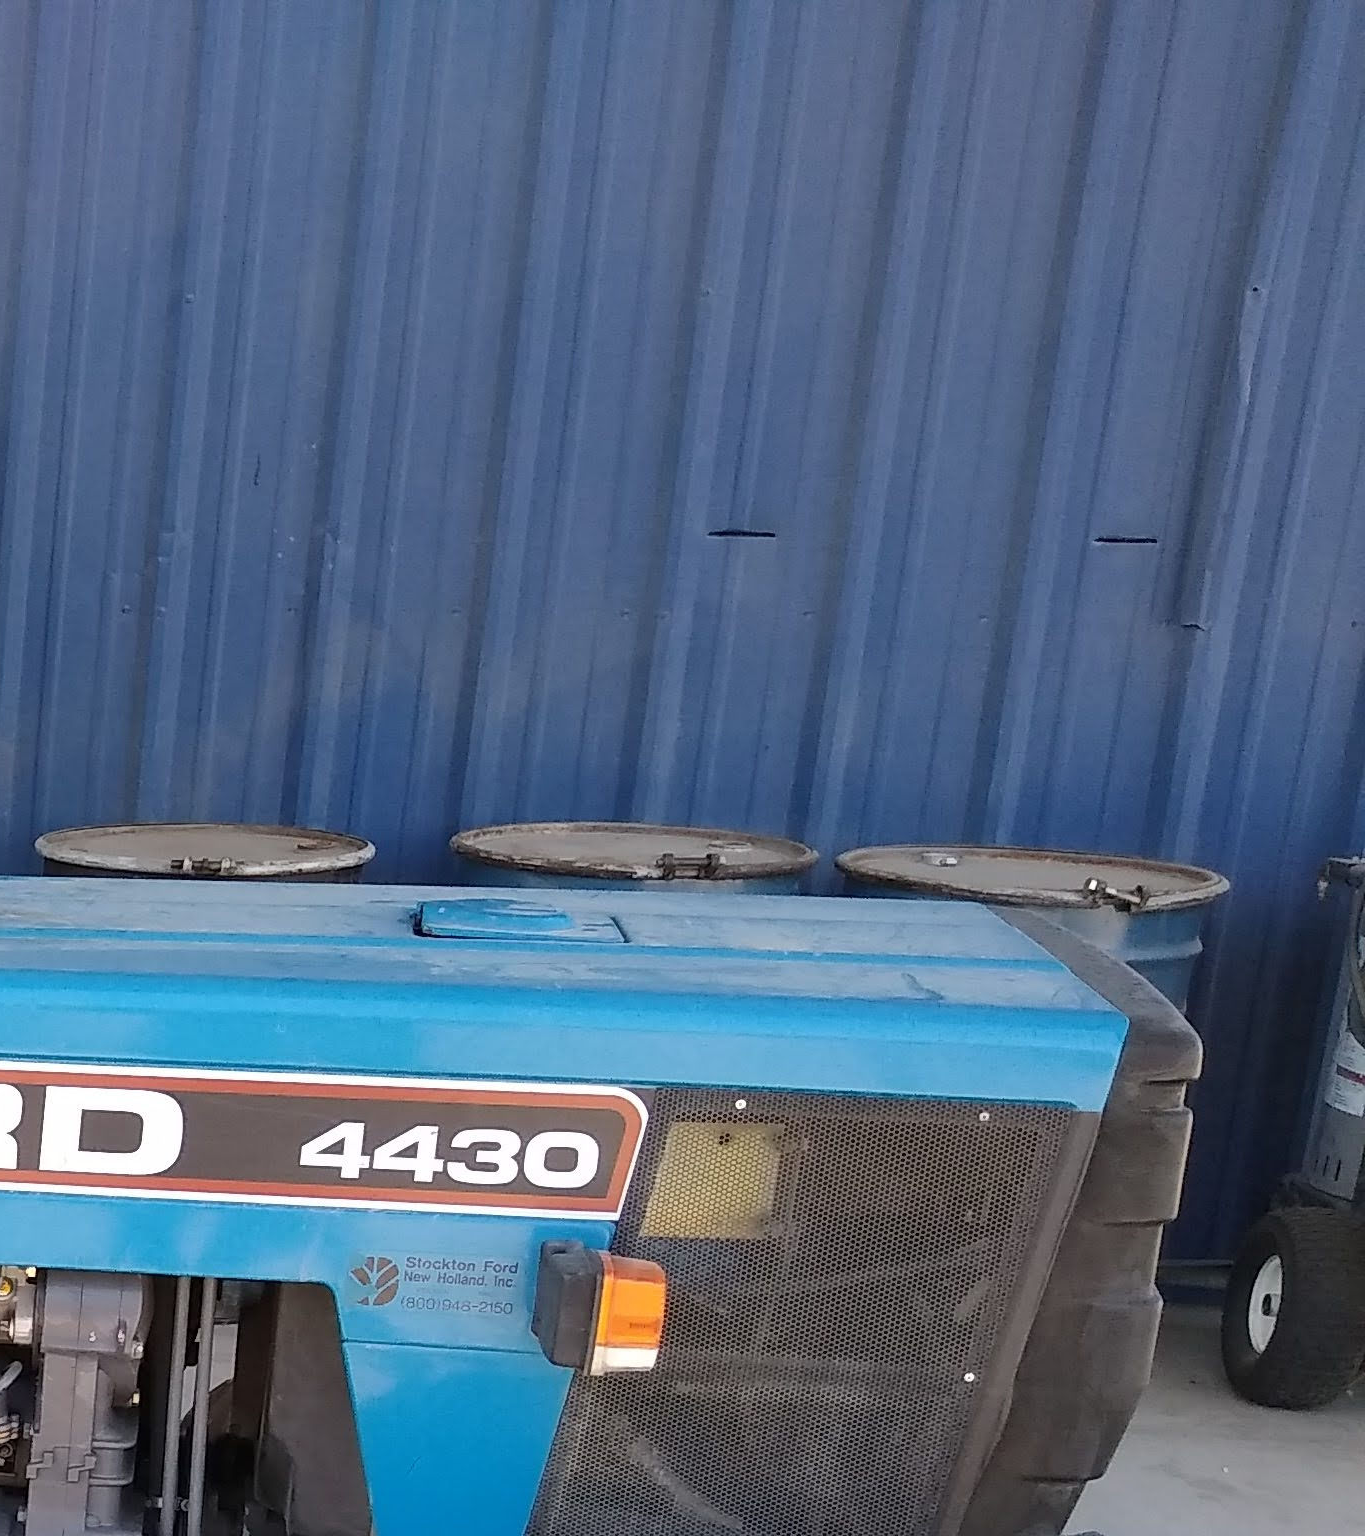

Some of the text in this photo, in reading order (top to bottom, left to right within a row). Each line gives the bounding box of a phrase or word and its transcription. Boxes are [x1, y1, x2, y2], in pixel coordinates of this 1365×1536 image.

[299, 1121, 600, 1189] 4430
[405, 1256, 519, 1274] Stockton Ford
[404, 1271, 431, 1283] New
[494, 1275, 517, 1288] Inc.
